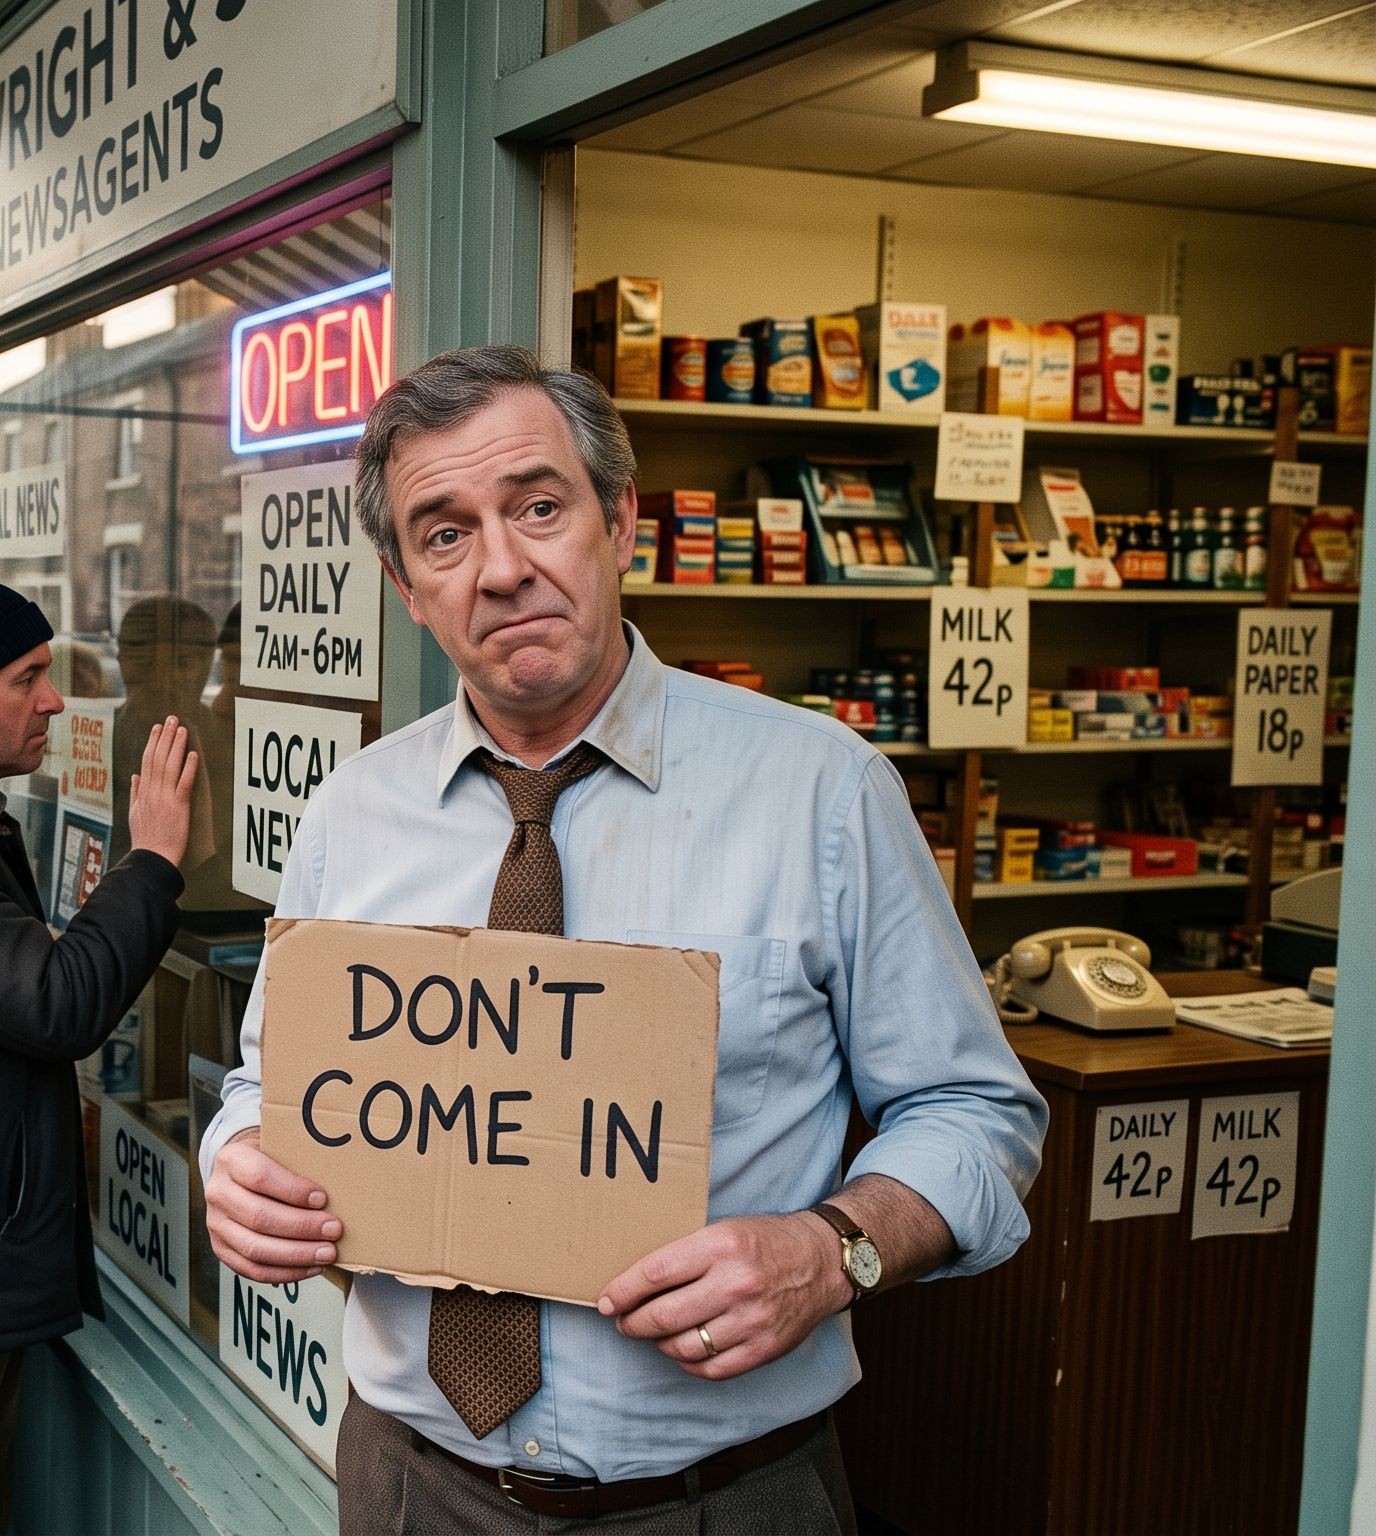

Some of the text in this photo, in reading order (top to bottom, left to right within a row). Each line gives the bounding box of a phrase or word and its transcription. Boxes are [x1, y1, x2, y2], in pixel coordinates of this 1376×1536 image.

[240, 292, 392, 433] OPEN
[16, 478, 60, 537] NEWS
[261, 485, 351, 550] OPEN
[259, 561, 351, 615] DAILY
[255, 625, 362, 677] 7AM-6PM
[941, 607, 1013, 642] MILK
[1248, 626, 1317, 655] DAILY
[943, 657, 1013, 717] 42p
[1244, 664, 1319, 695] PAPER
[1257, 708, 1304, 760] 18p
[246, 803, 301, 874] NE
[346, 963, 606, 1061] DON'T
[301, 1069, 664, 1183] COME IN
[1109, 1112, 1177, 1142] DAILY
[1212, 1107, 1283, 1143] MILK
[115, 1127, 166, 1207] OPEN
[1206, 1154, 1282, 1218] 42p
[108, 1178, 177, 1289] LOCAL
[233, 1274, 327, 1427] NEWS
